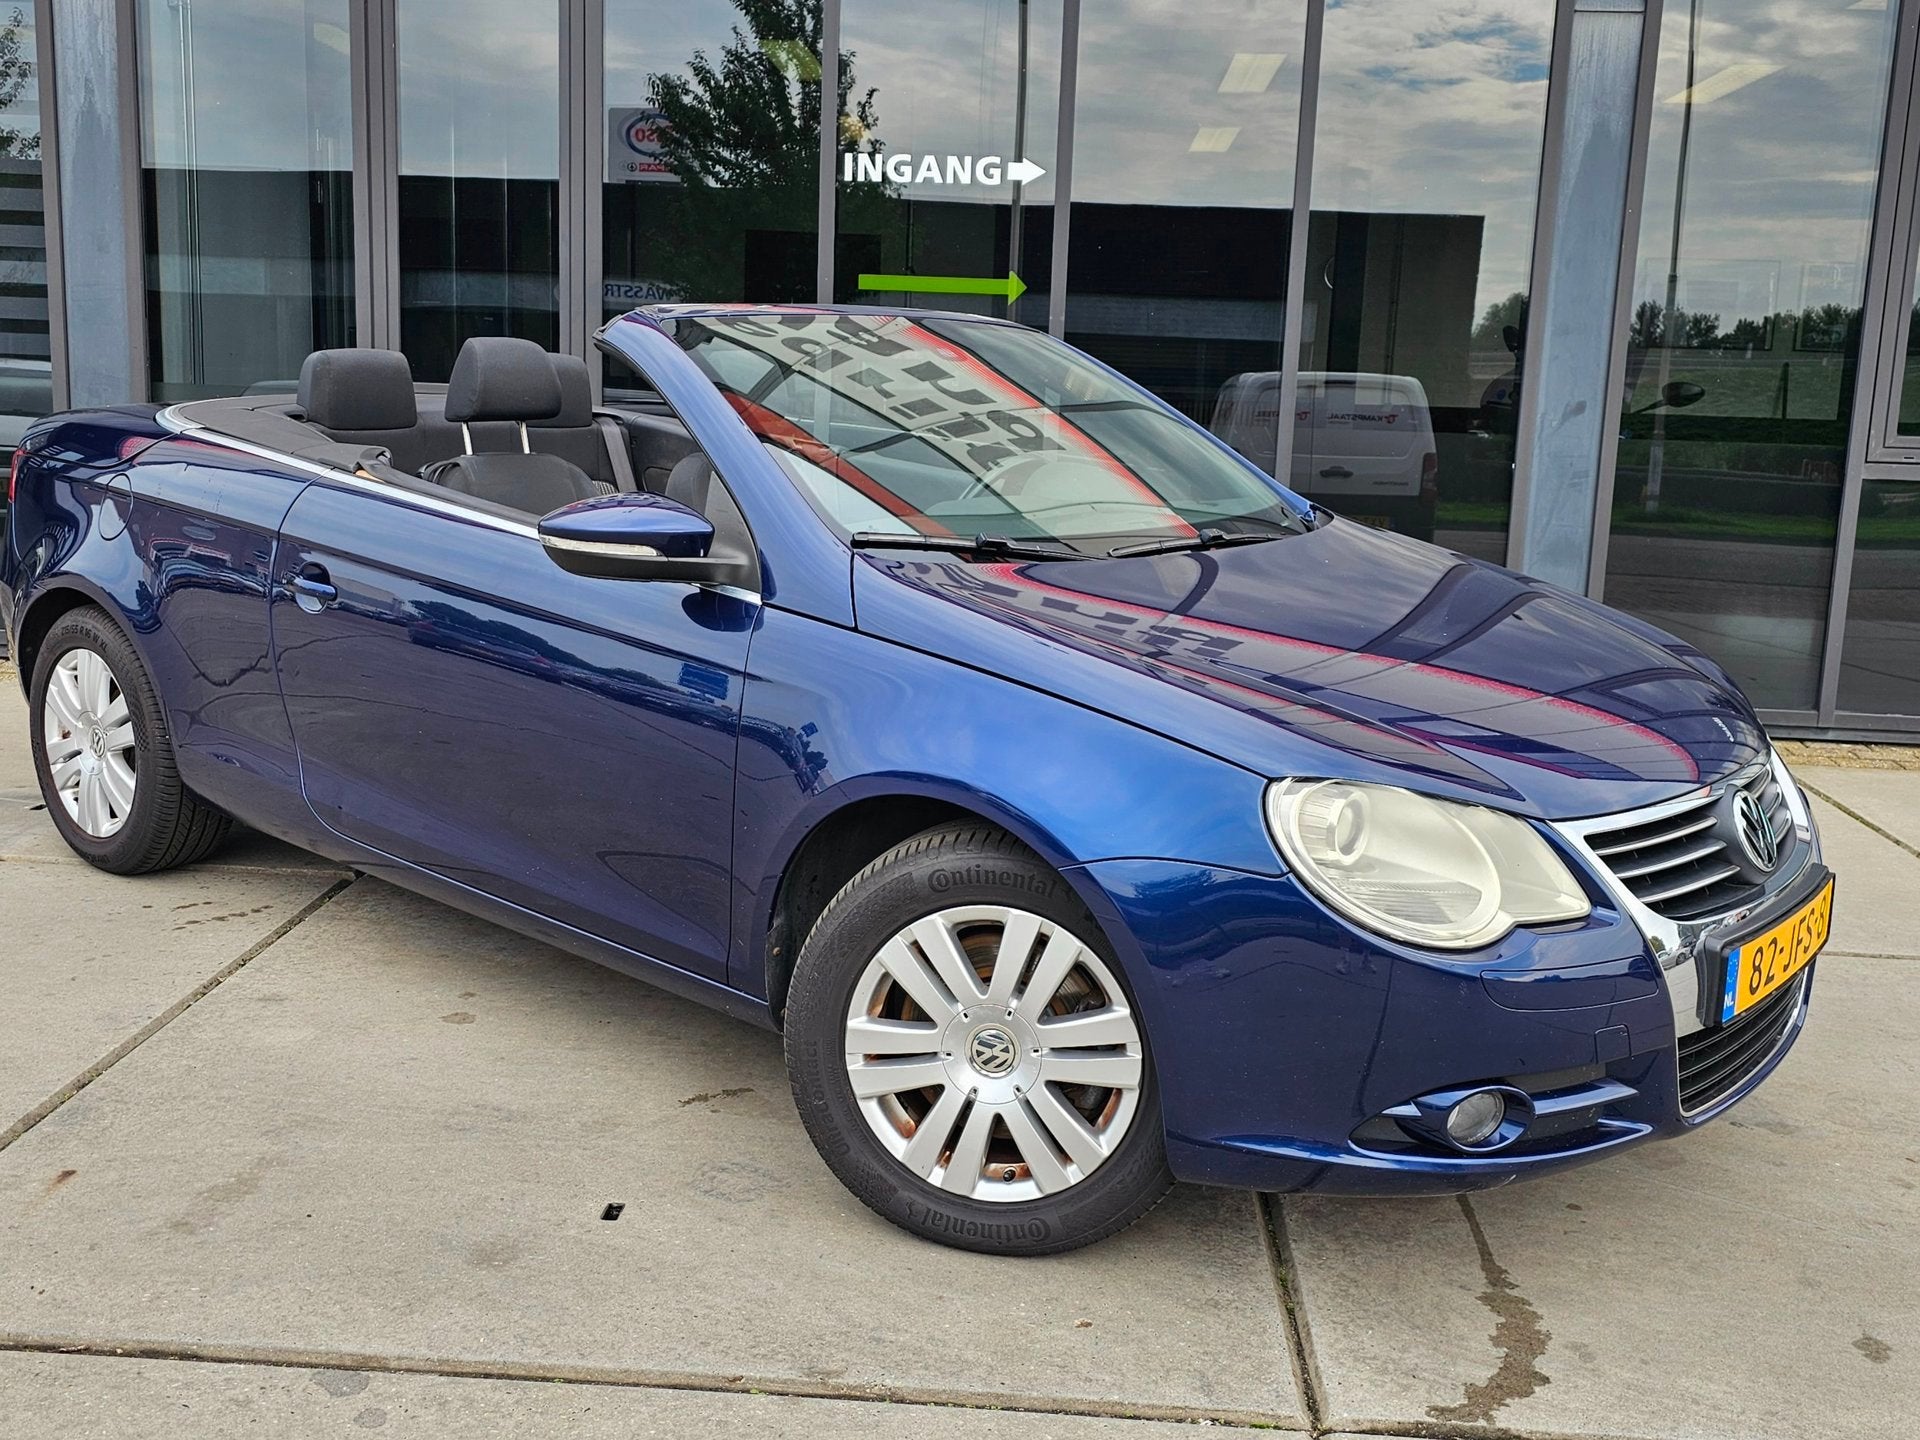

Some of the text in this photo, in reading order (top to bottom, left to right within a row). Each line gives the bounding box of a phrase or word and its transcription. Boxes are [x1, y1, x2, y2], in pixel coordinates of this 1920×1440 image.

[844, 152, 1001, 185] INGANG
[927, 863, 1057, 898] Continental
[1749, 894, 1826, 996] 82-JFS-8
[1723, 991, 1734, 1008] NL
[921, 1207, 1052, 1246] Continental
